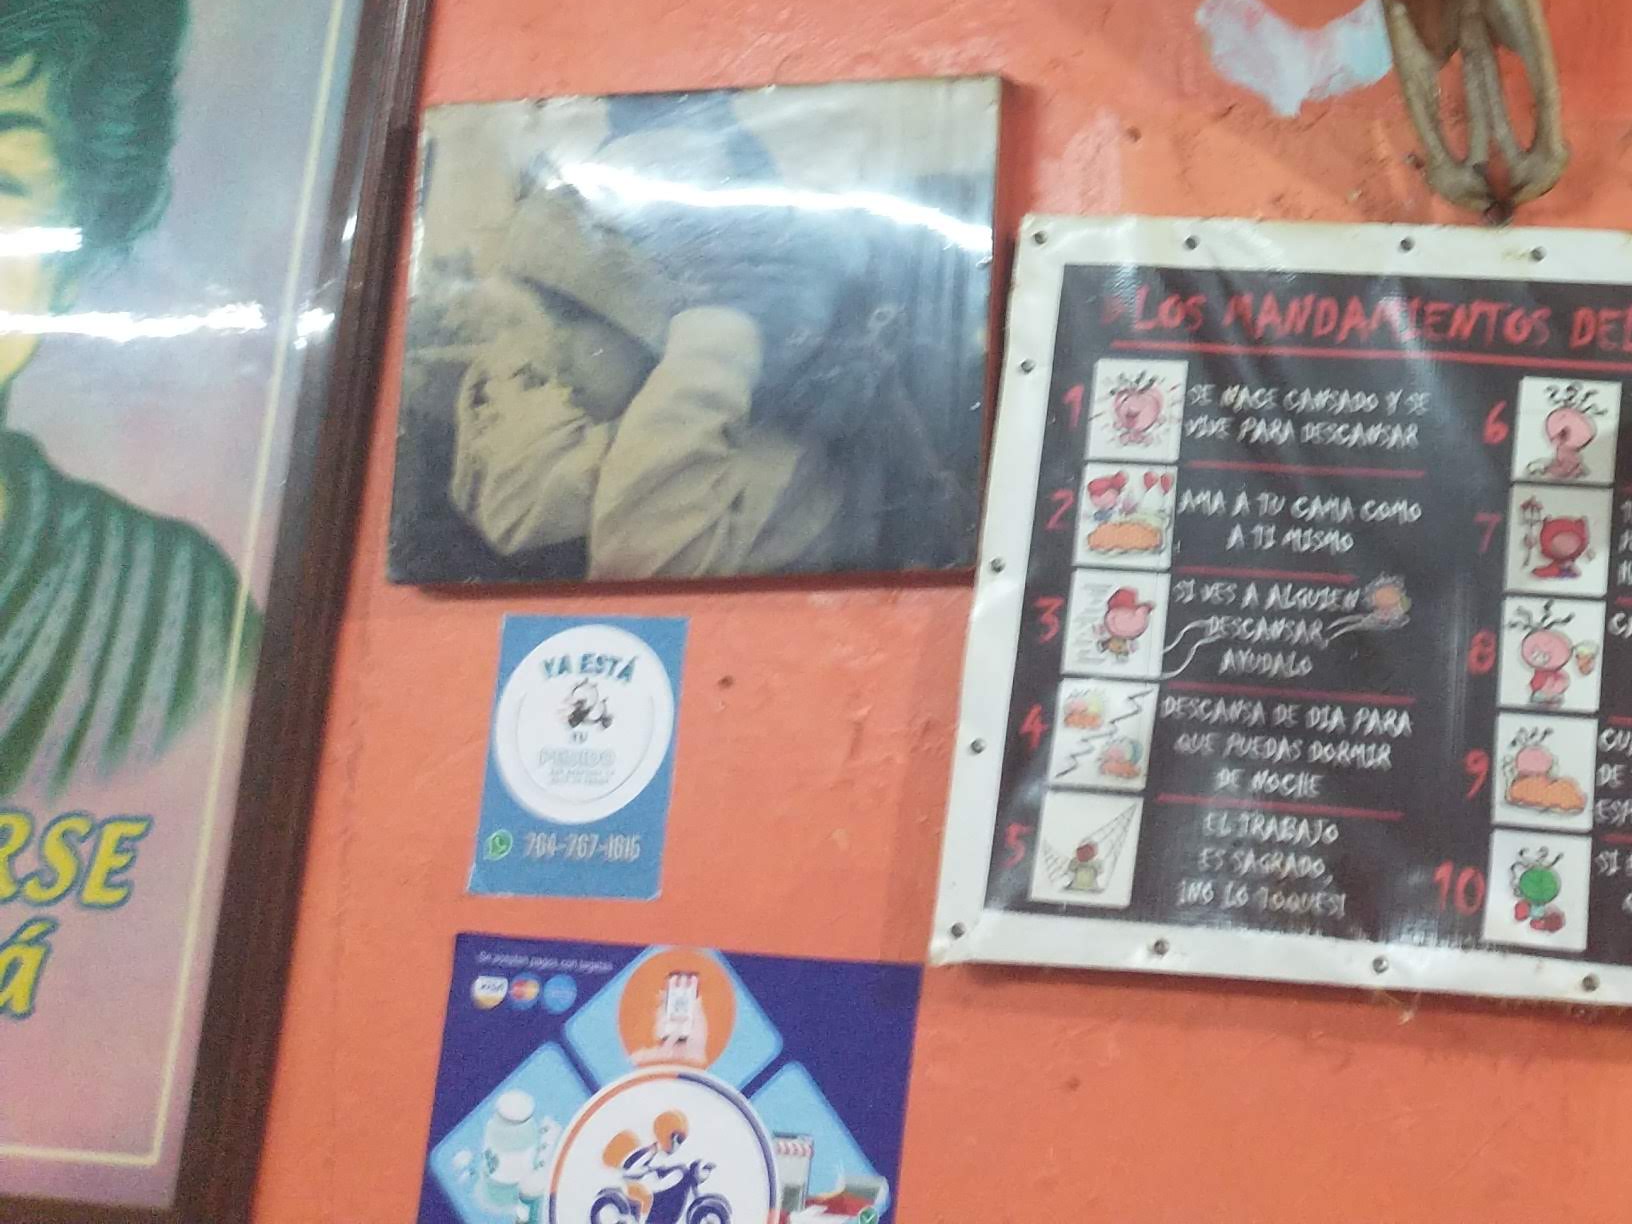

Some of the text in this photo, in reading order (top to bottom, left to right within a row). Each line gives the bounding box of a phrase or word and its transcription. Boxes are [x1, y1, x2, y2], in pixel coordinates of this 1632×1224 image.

[1135, 283, 1207, 334] LOS
[1222, 289, 1552, 347] MANDAMIENTOS
[1062, 383, 1084, 429] 1
[1188, 384, 1216, 407] SE
[1283, 387, 1380, 415] CANSADO
[1385, 389, 1403, 416] Y
[1405, 392, 1431, 416] SE
[1186, 414, 1419, 449] VIVE PARA DESCANSAR
[1483, 400, 1510, 445] 6
[1044, 488, 1077, 532] 2
[1177, 489, 1226, 517] AMA
[1257, 492, 1287, 516] TU
[1290, 495, 1355, 523] CAMA
[1360, 499, 1423, 524] COMO
[1225, 524, 1355, 555] A TI MISMO
[1474, 512, 1501, 555] 7
[1173, 579, 1196, 605] SI
[1241, 582, 1260, 609] A
[1264, 583, 1362, 613] ALGUIEN
[1032, 595, 1065, 644] 3
[542, 655, 572, 680] YA
[1219, 648, 1313, 678] AYUDALO
[1467, 628, 1497, 675] 8
[1020, 704, 1048, 750] 4
[1160, 695, 1266, 726] DESCANSA
[1272, 703, 1301, 727] DE
[1352, 707, 1414, 738] PARA
[1173, 732, 1394, 771] QUE PUEDAS DORMIR
[1214, 767, 1325, 799] DE NOCHE
[1464, 747, 1491, 801] 9
[1596, 763, 1626, 787] DE
[1002, 822, 1032, 869] 5
[1203, 811, 1340, 848] EL TRABAJO
[1198, 847, 1226, 872] ES
[1595, 850, 1621, 877] SI
[1220, 879, 1249, 910] LO
[1434, 858, 1487, 915] 10
